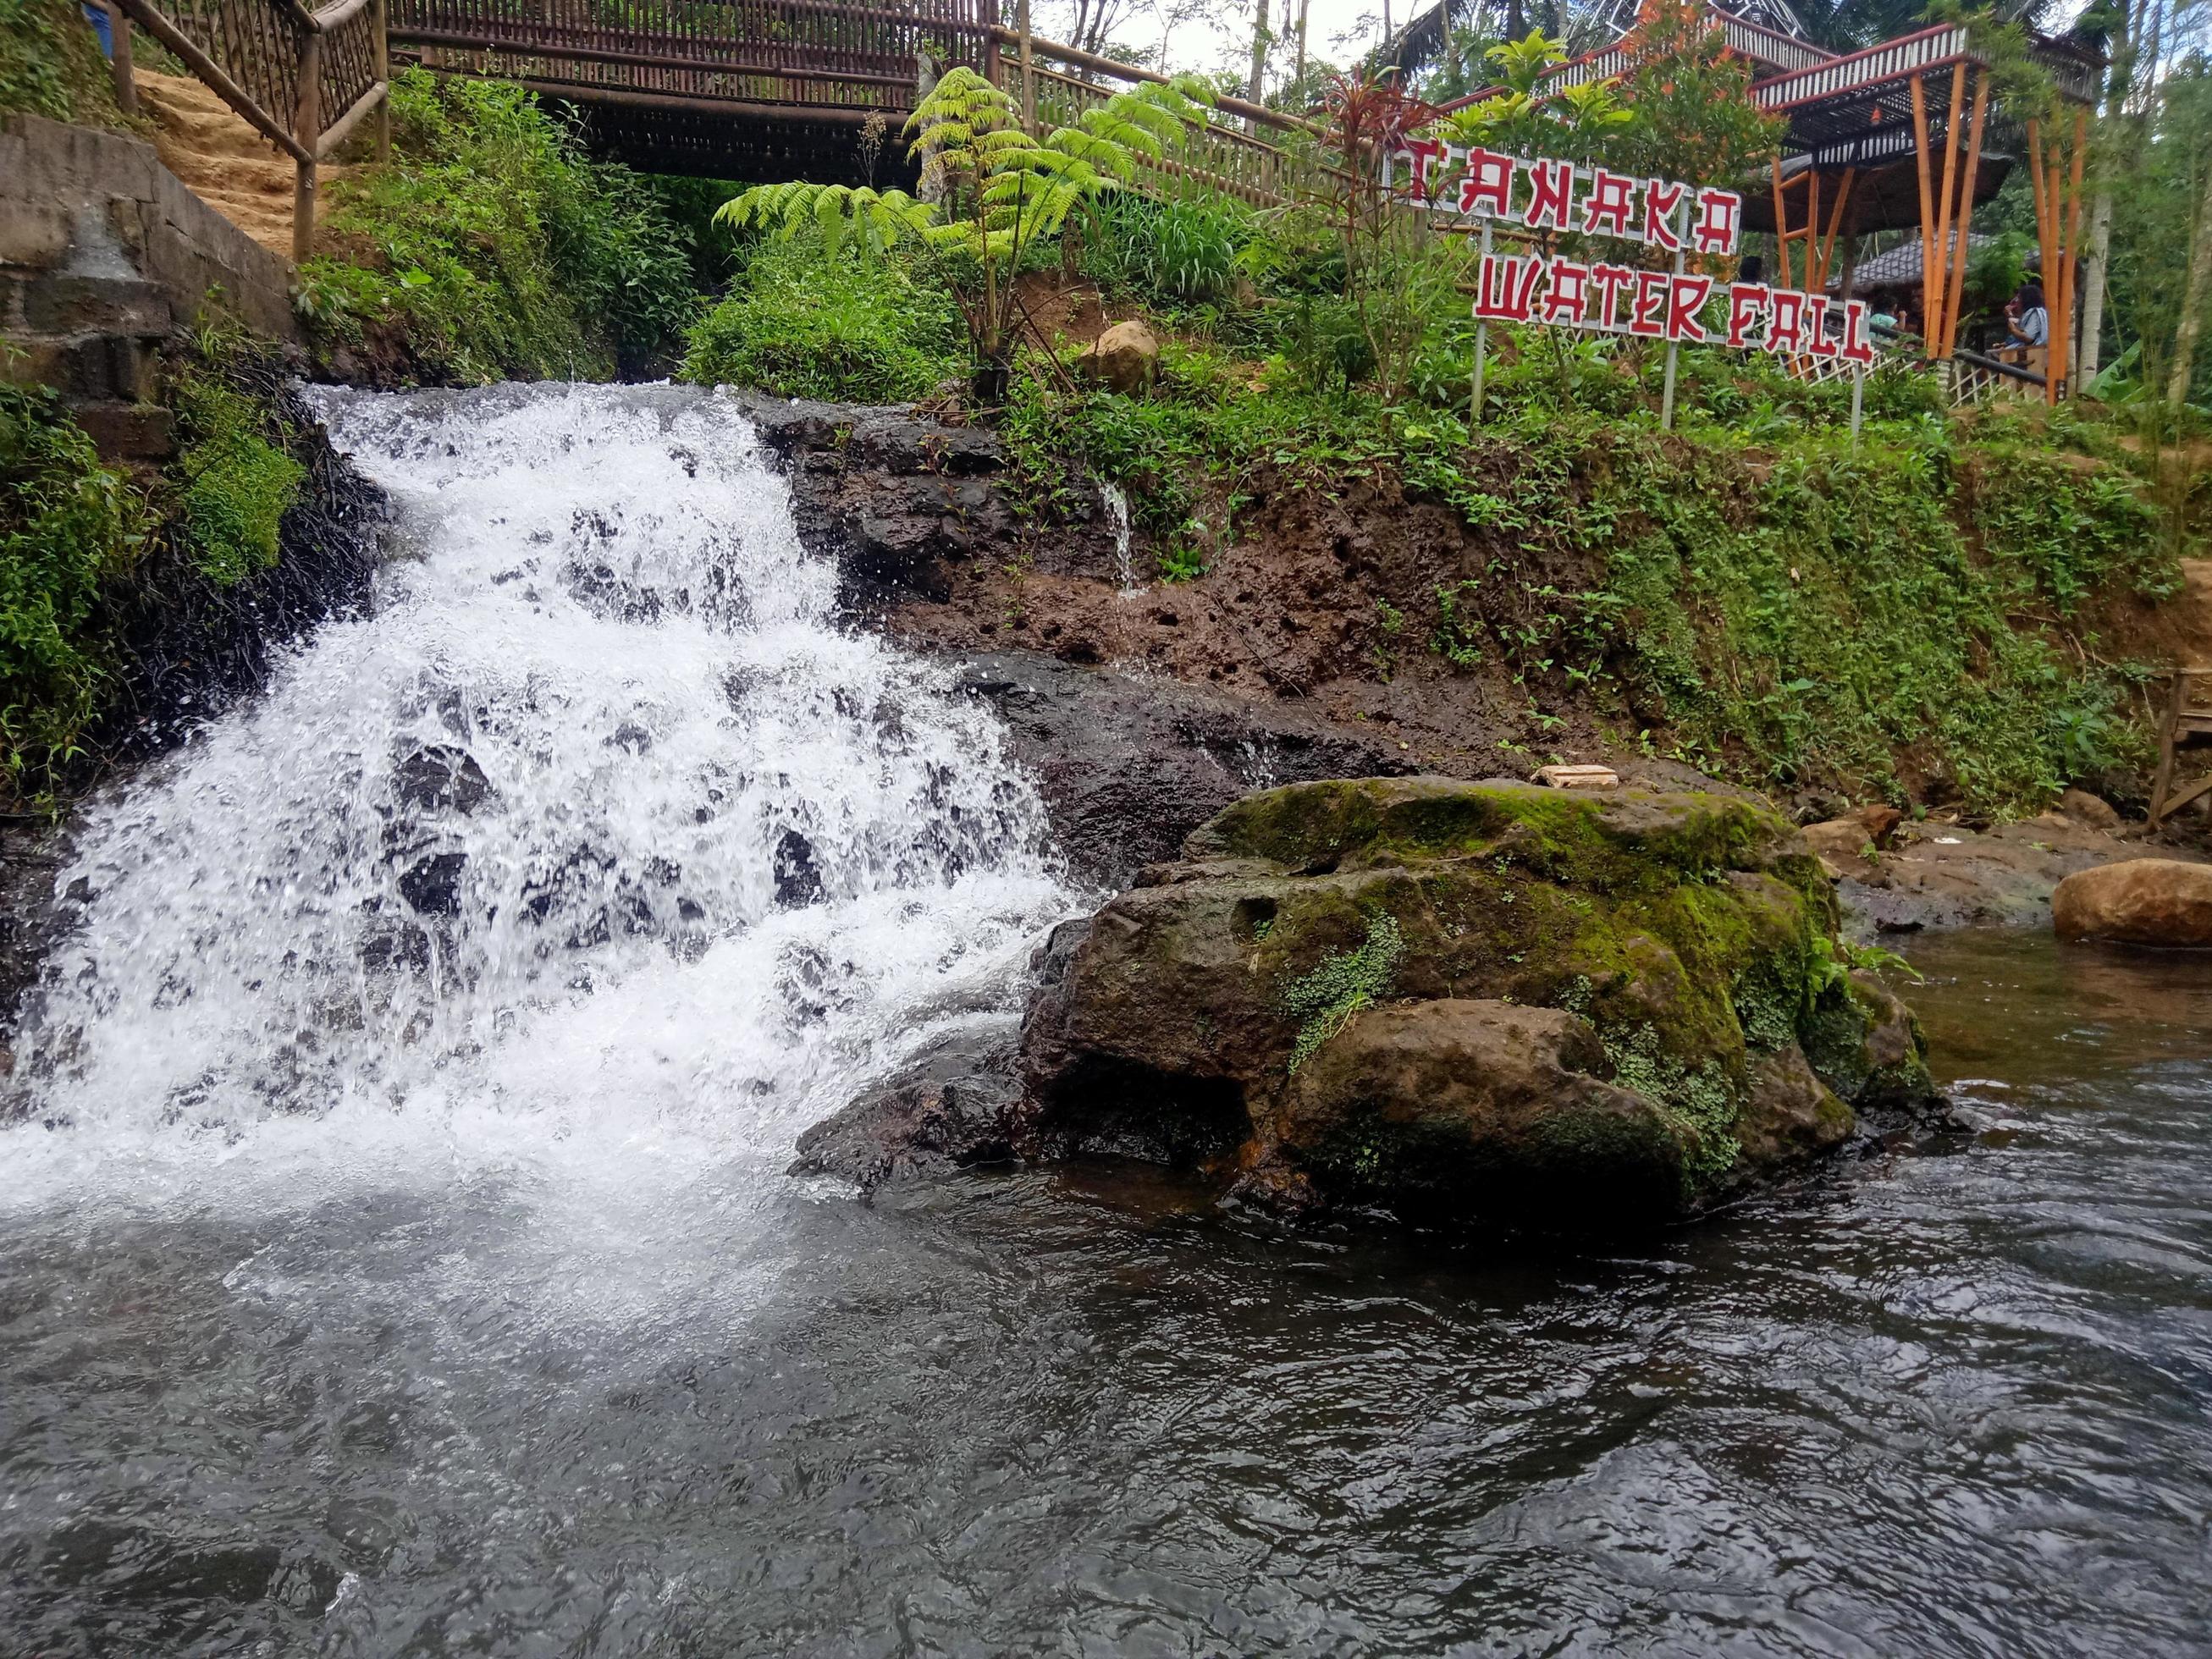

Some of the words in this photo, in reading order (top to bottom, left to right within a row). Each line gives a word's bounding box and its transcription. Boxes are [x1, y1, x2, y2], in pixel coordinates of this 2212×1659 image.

[1394, 138, 1740, 255] TANAKA
[1474, 254, 1712, 341] WATER
[1727, 284, 1874, 365] FALL
